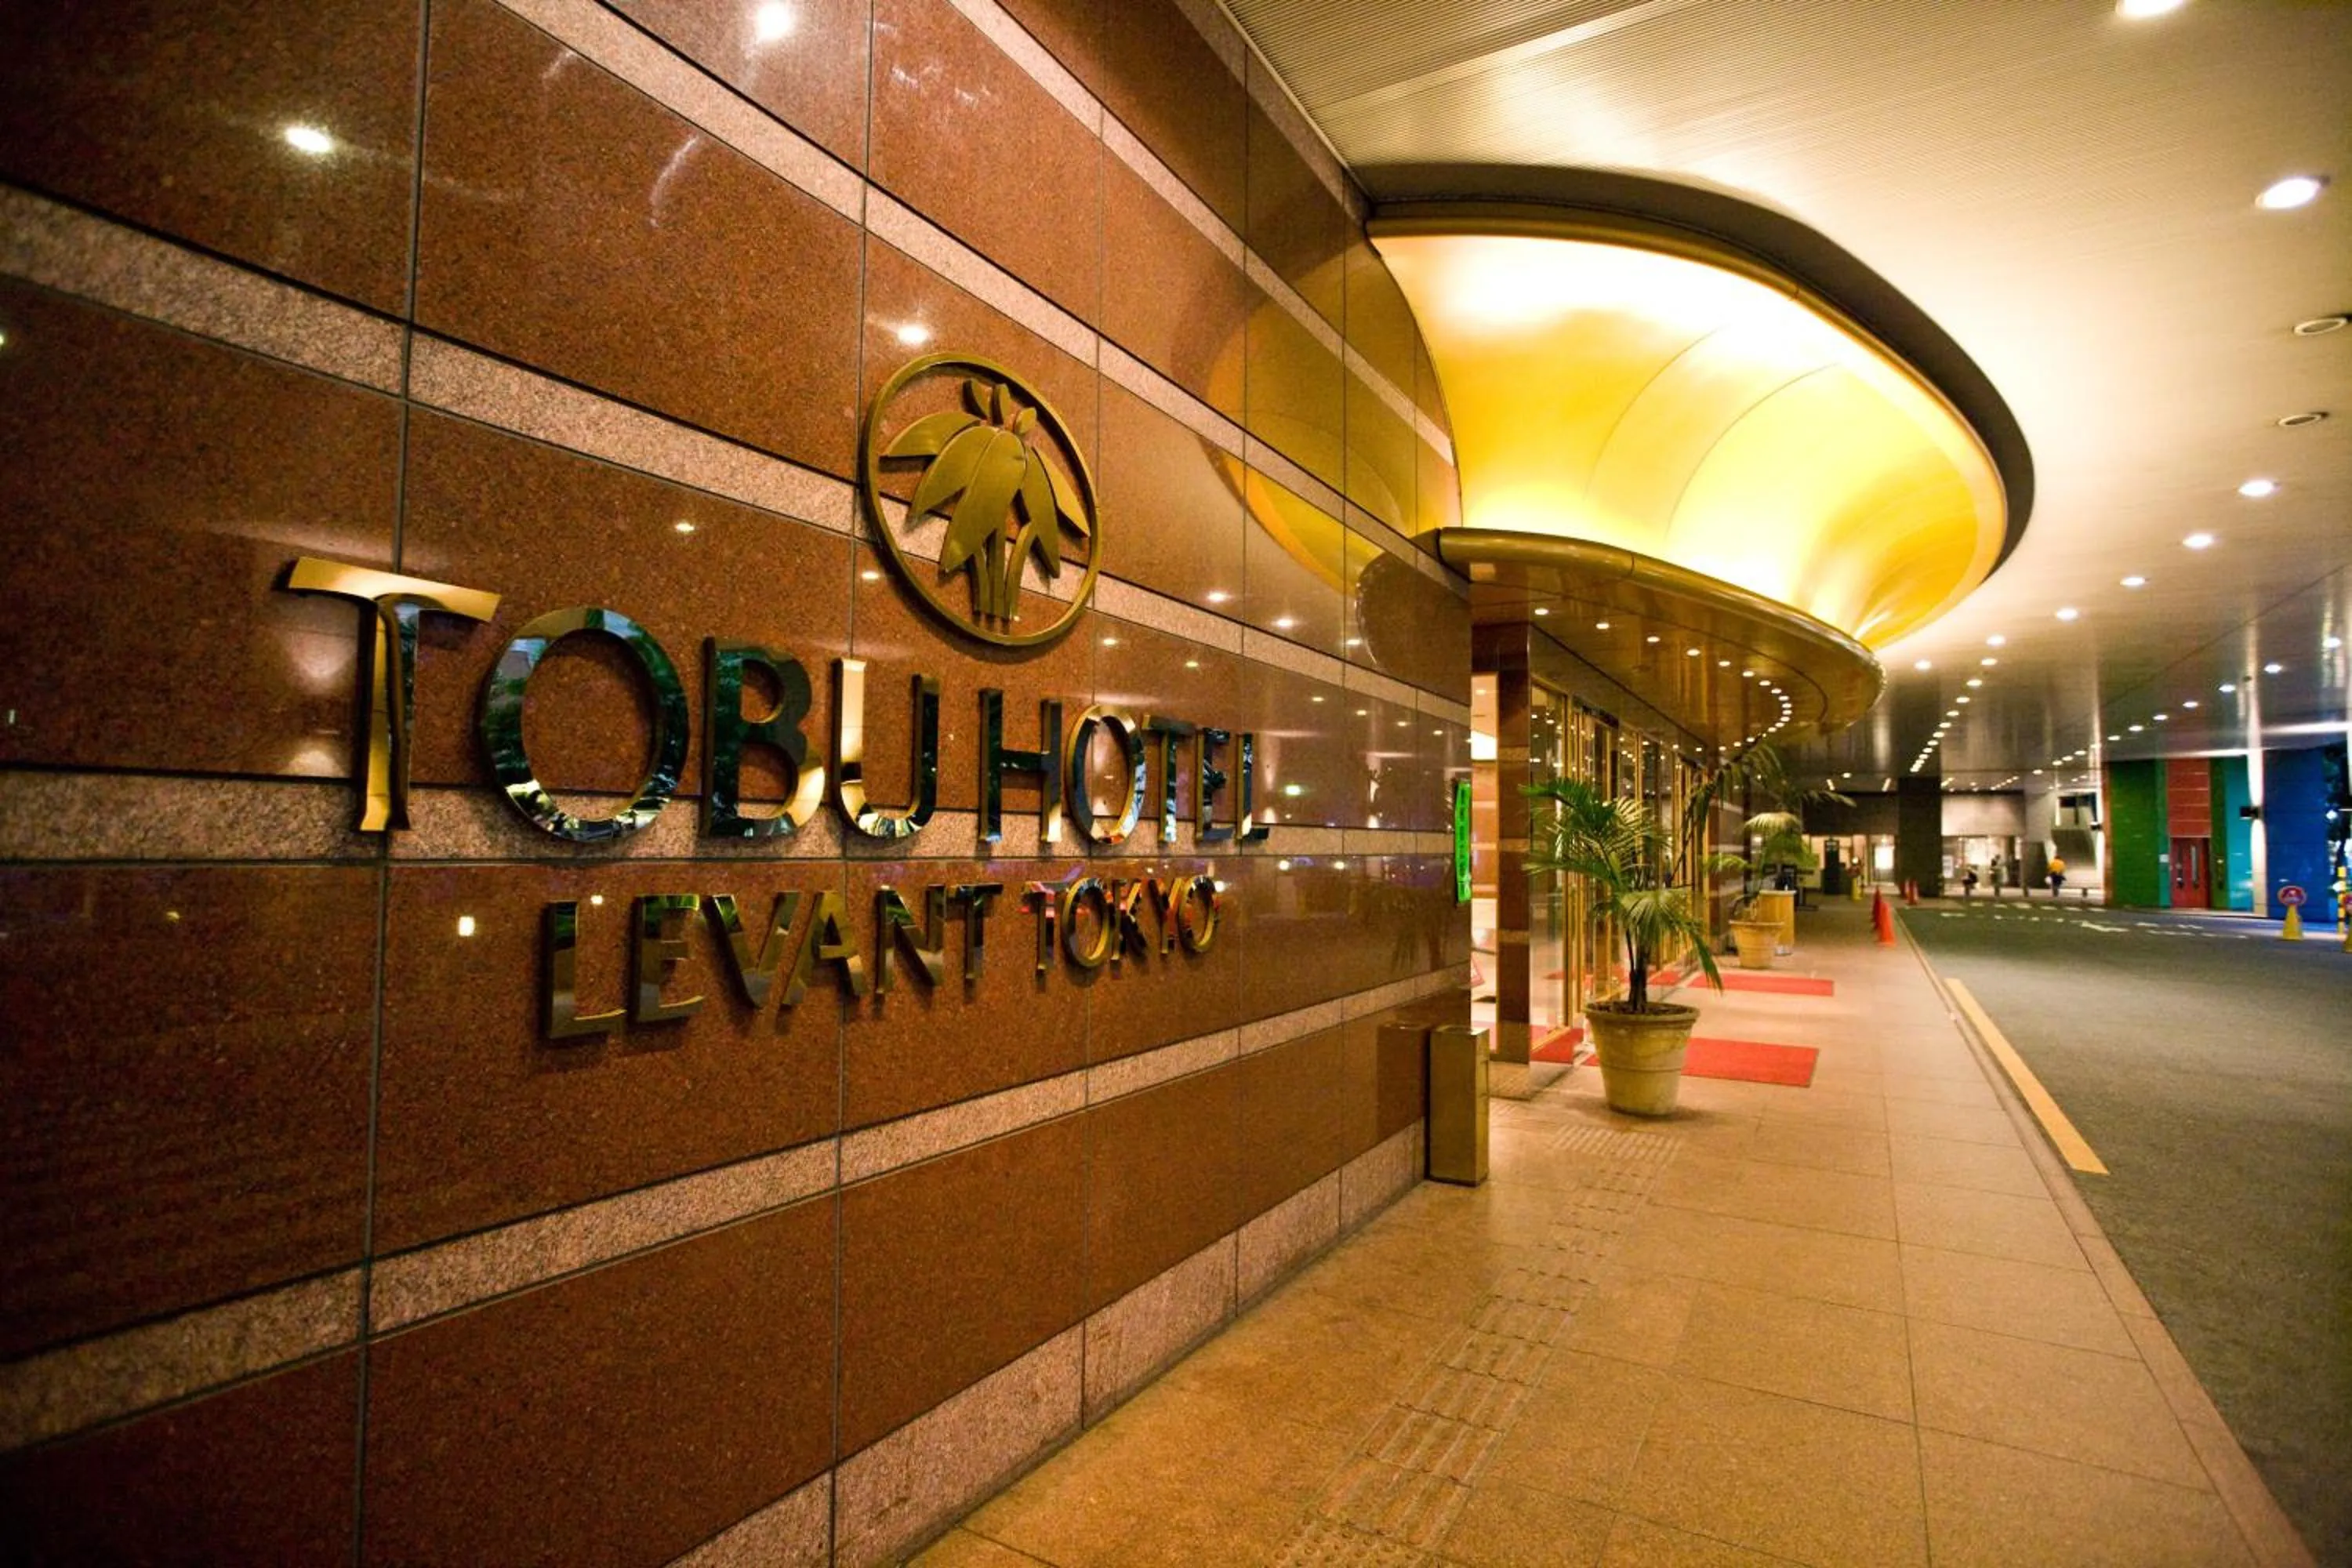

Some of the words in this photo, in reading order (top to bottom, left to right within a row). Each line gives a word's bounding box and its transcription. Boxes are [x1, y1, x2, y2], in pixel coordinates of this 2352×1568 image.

[287, 555, 938, 841] TOBU
[979, 688, 1269, 846] HOTEL
[545, 883, 1004, 1039] LEVANT
[1022, 876, 1220, 972] TOKYO
